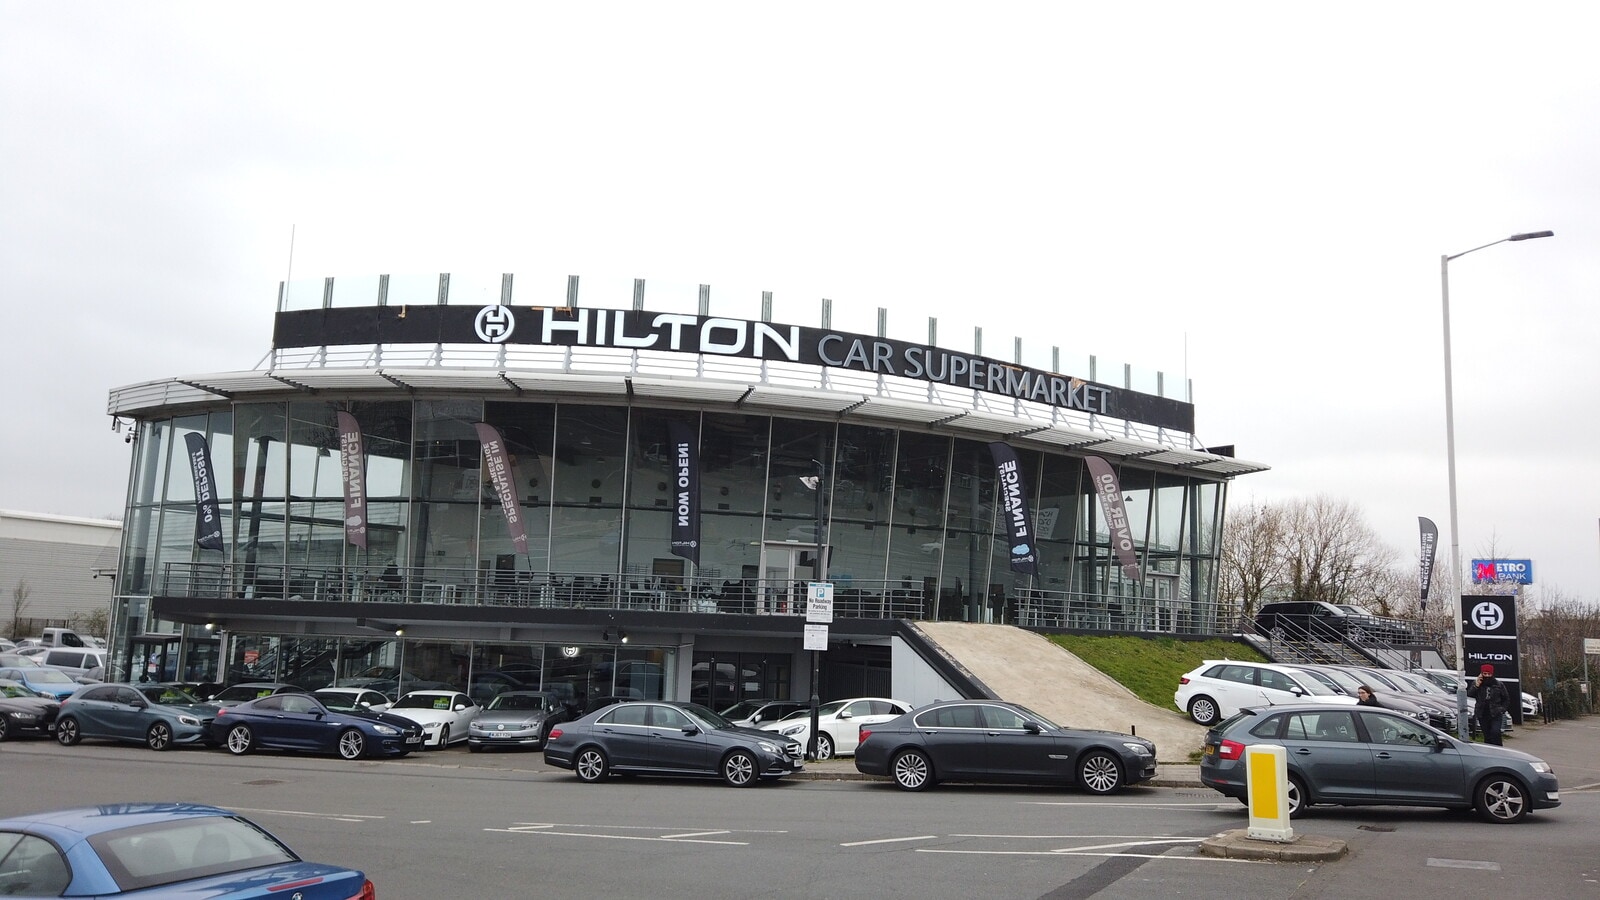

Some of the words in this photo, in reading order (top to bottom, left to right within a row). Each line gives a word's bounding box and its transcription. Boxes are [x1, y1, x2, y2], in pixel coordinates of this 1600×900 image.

[542, 308, 800, 361] HILTON
[818, 334, 895, 374] CAR
[904, 347, 1112, 414] SUPERMARKET
[1477, 563, 1526, 580] METRO
[1498, 572, 1526, 580] BANK
[1468, 652, 1513, 660] HILTON
